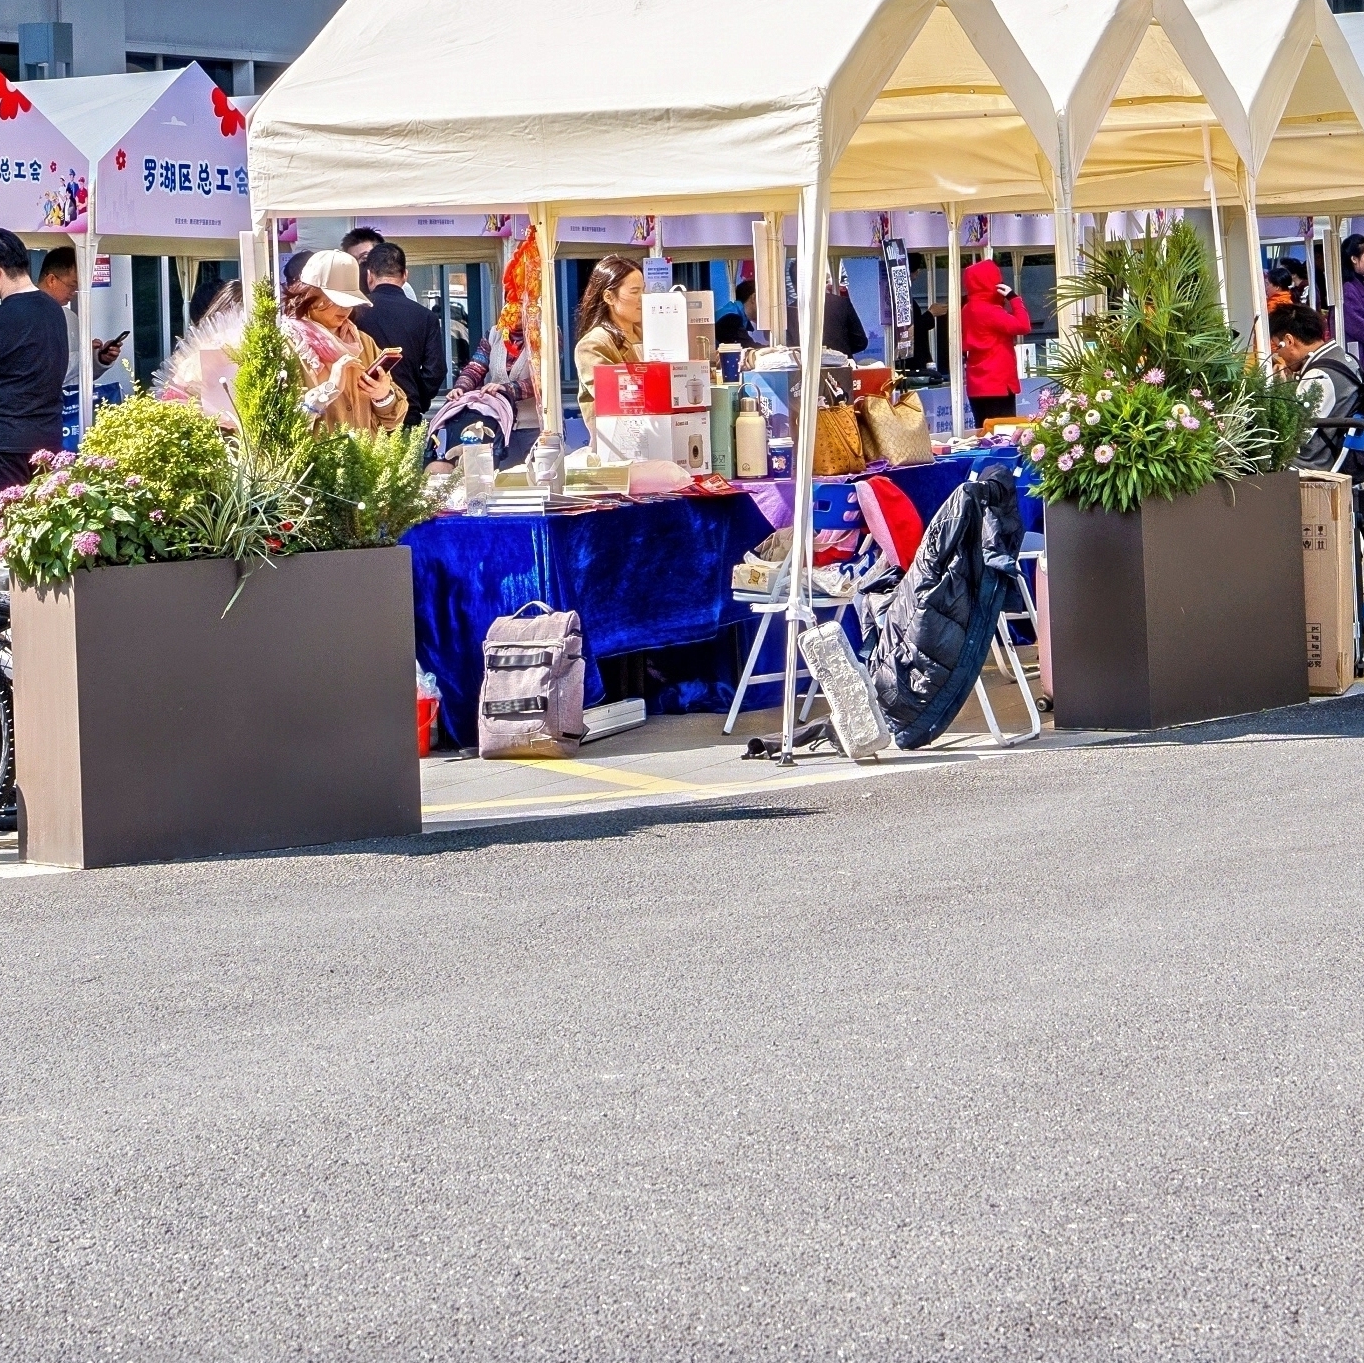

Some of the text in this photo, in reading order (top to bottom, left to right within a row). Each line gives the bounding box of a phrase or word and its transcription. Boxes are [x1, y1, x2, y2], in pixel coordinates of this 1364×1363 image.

[144, 158, 248, 195] 罗湖区总工会
